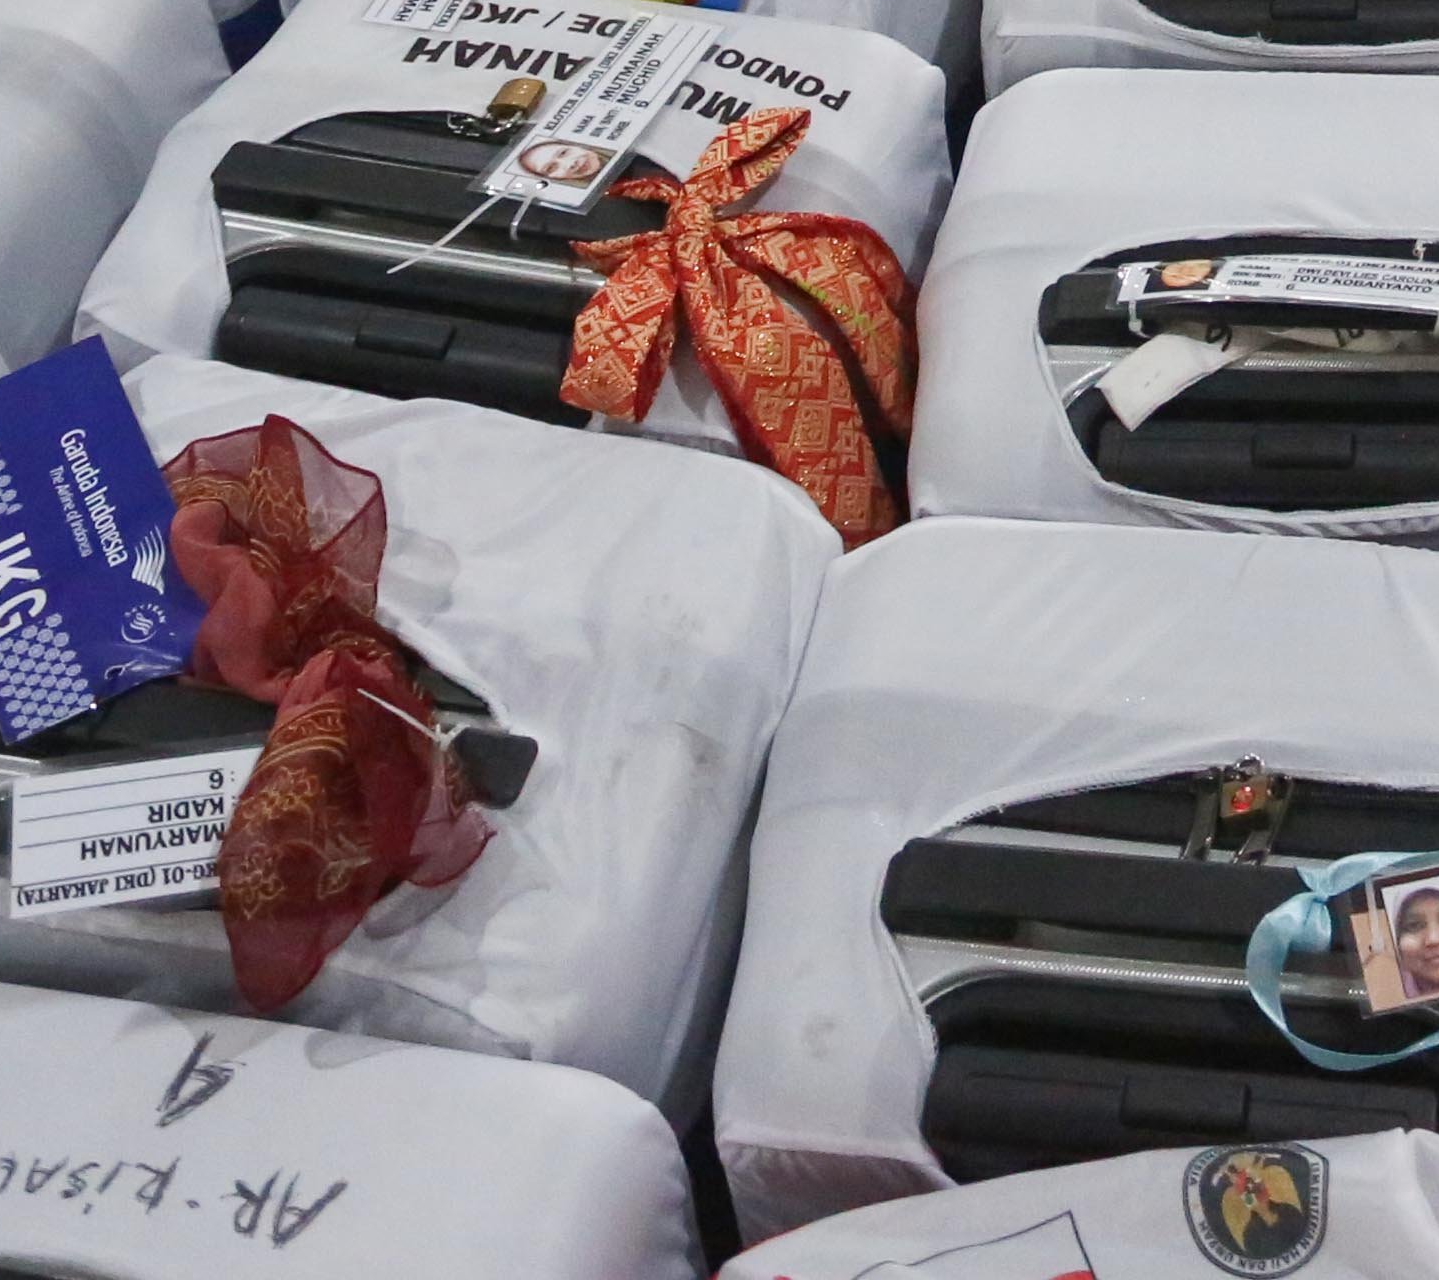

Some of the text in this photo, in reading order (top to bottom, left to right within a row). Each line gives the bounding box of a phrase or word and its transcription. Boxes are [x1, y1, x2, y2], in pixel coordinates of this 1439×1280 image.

[565, 11, 623, 39] DE
[542, 97, 579, 131] KLOTER
[596, 50, 622, 69] (DKI
[611, 15, 652, 51] JAKARTA)
[571, 32, 664, 134] NAMA MUTMAINAH
[616, 58, 662, 104] MUCHID
[632, 98, 650, 108] 6
[1293, 273, 1328, 284] TOTO
[47, 463, 68, 485] The
[58, 423, 132, 570] Garuda Indonesia
[208, 768, 223, 790] 6
[146, 794, 224, 824] KADIR
[79, 819, 225, 861] MARYUNAH
[15, 865, 155, 908] (DKI JAKARTA)
